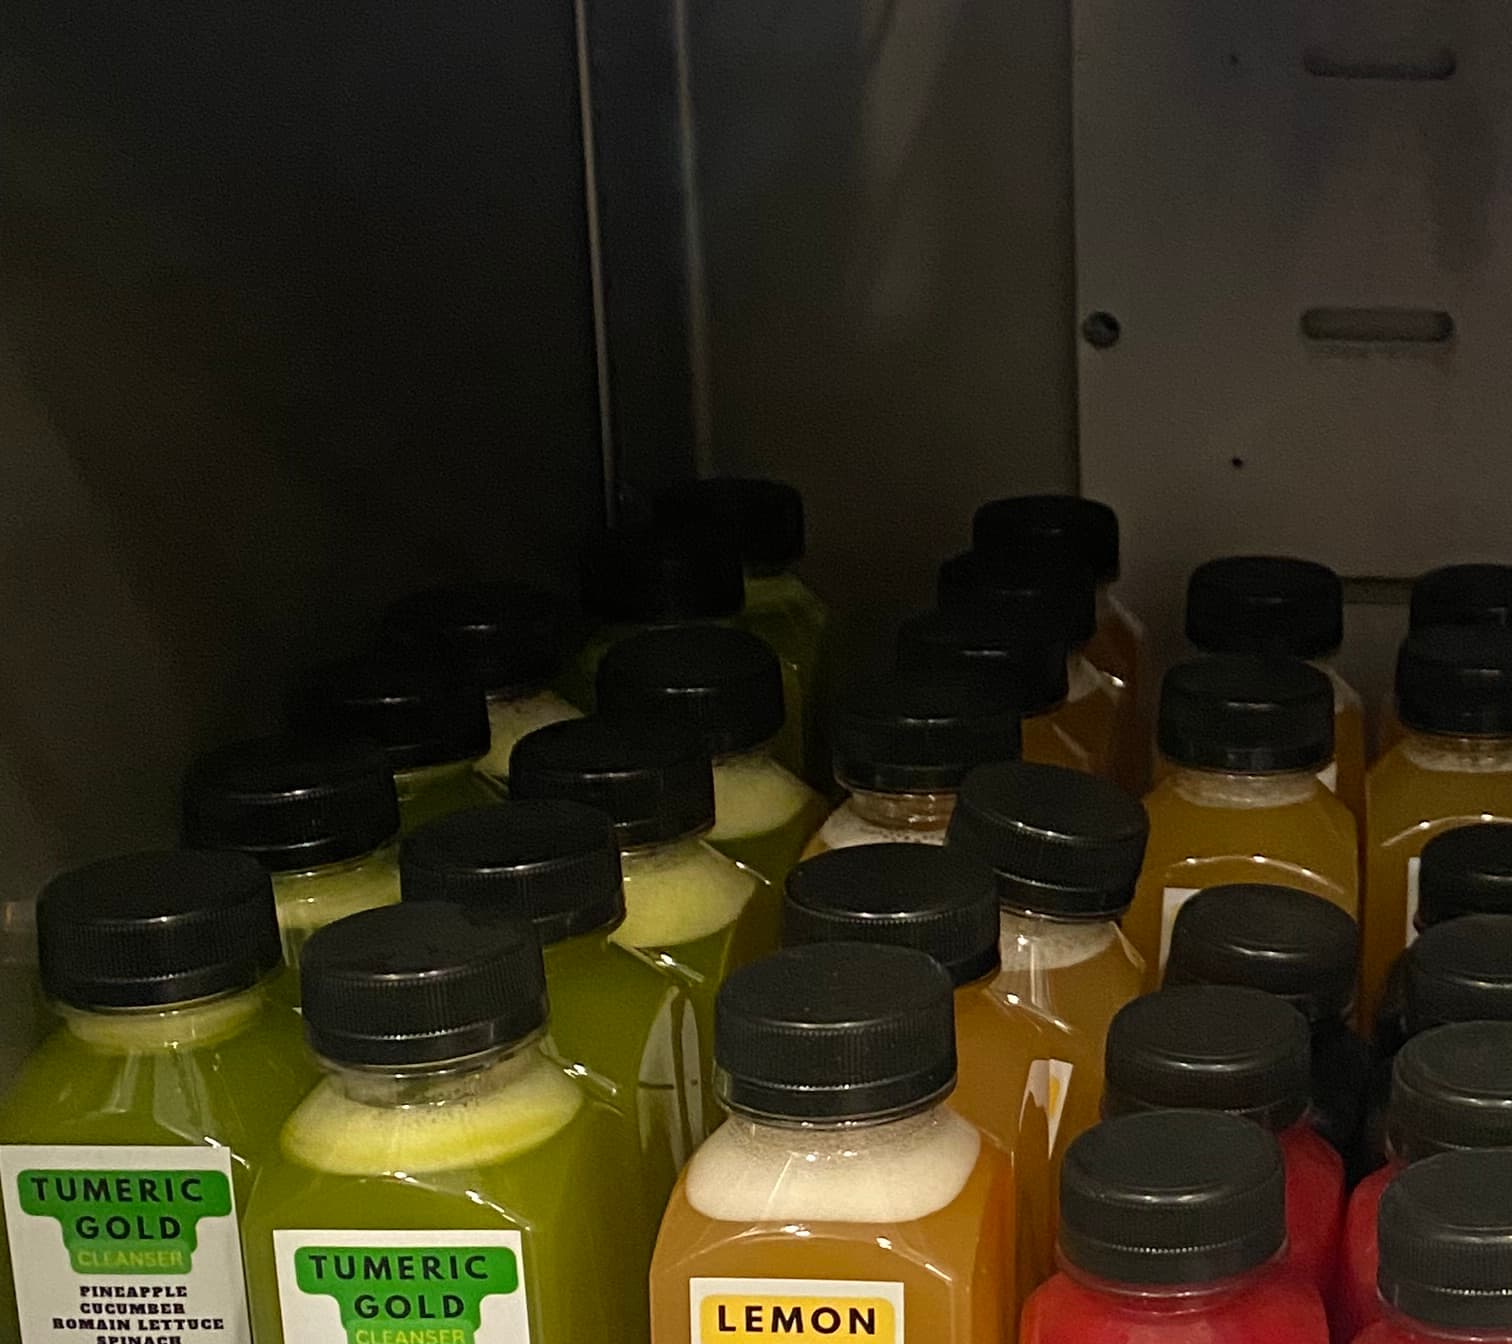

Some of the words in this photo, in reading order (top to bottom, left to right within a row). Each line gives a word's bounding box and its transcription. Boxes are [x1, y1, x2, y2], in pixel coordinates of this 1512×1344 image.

[30, 1178, 203, 1202] TUMERIC
[75, 1216, 180, 1240] GOLD
[78, 1250, 184, 1266] CLEANSER
[309, 1256, 488, 1280] TUMERIC
[80, 1286, 188, 1298] PINEAPPLE
[354, 1294, 465, 1319] GOLD
[52, 1318, 130, 1330] ROMAIN
[138, 1319, 224, 1330] LETTUCE
[718, 1305, 875, 1335] LEMON
